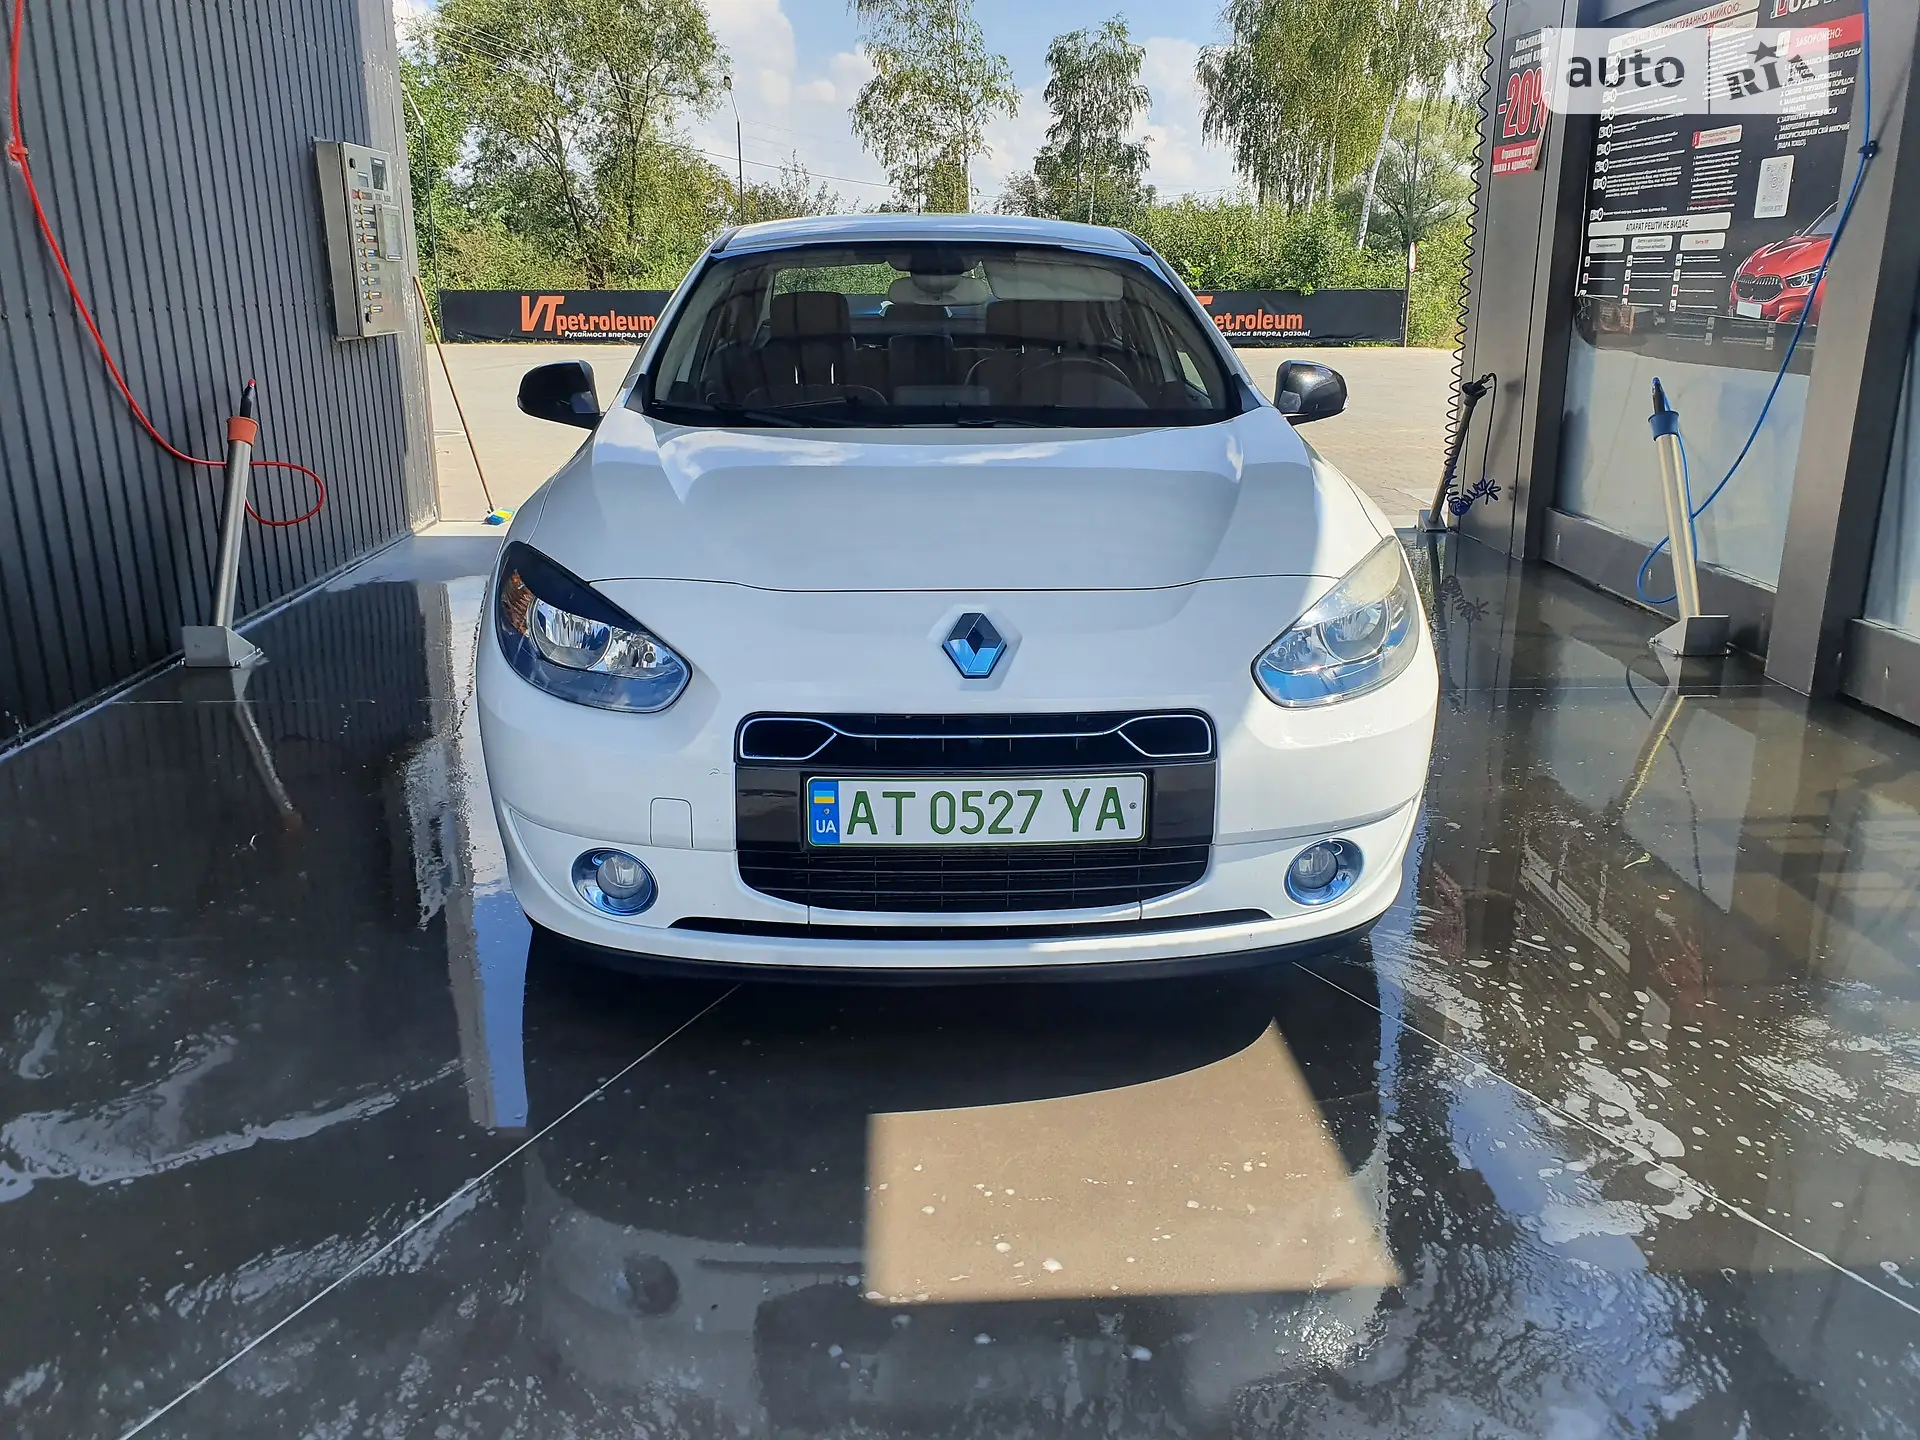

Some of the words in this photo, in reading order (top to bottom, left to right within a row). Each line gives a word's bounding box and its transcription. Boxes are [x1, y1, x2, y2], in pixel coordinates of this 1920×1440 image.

[520, 295, 565, 331] VT
[556, 310, 656, 335] petroleum
[1213, 309, 1303, 330] etroleum
[608, 331, 636, 339] вперед
[1283, 330, 1311, 338] разом!
[846, 790, 916, 835] AT
[930, 789, 1043, 835] 0527
[1062, 787, 1126, 833] YA
[816, 820, 837, 834] UA
